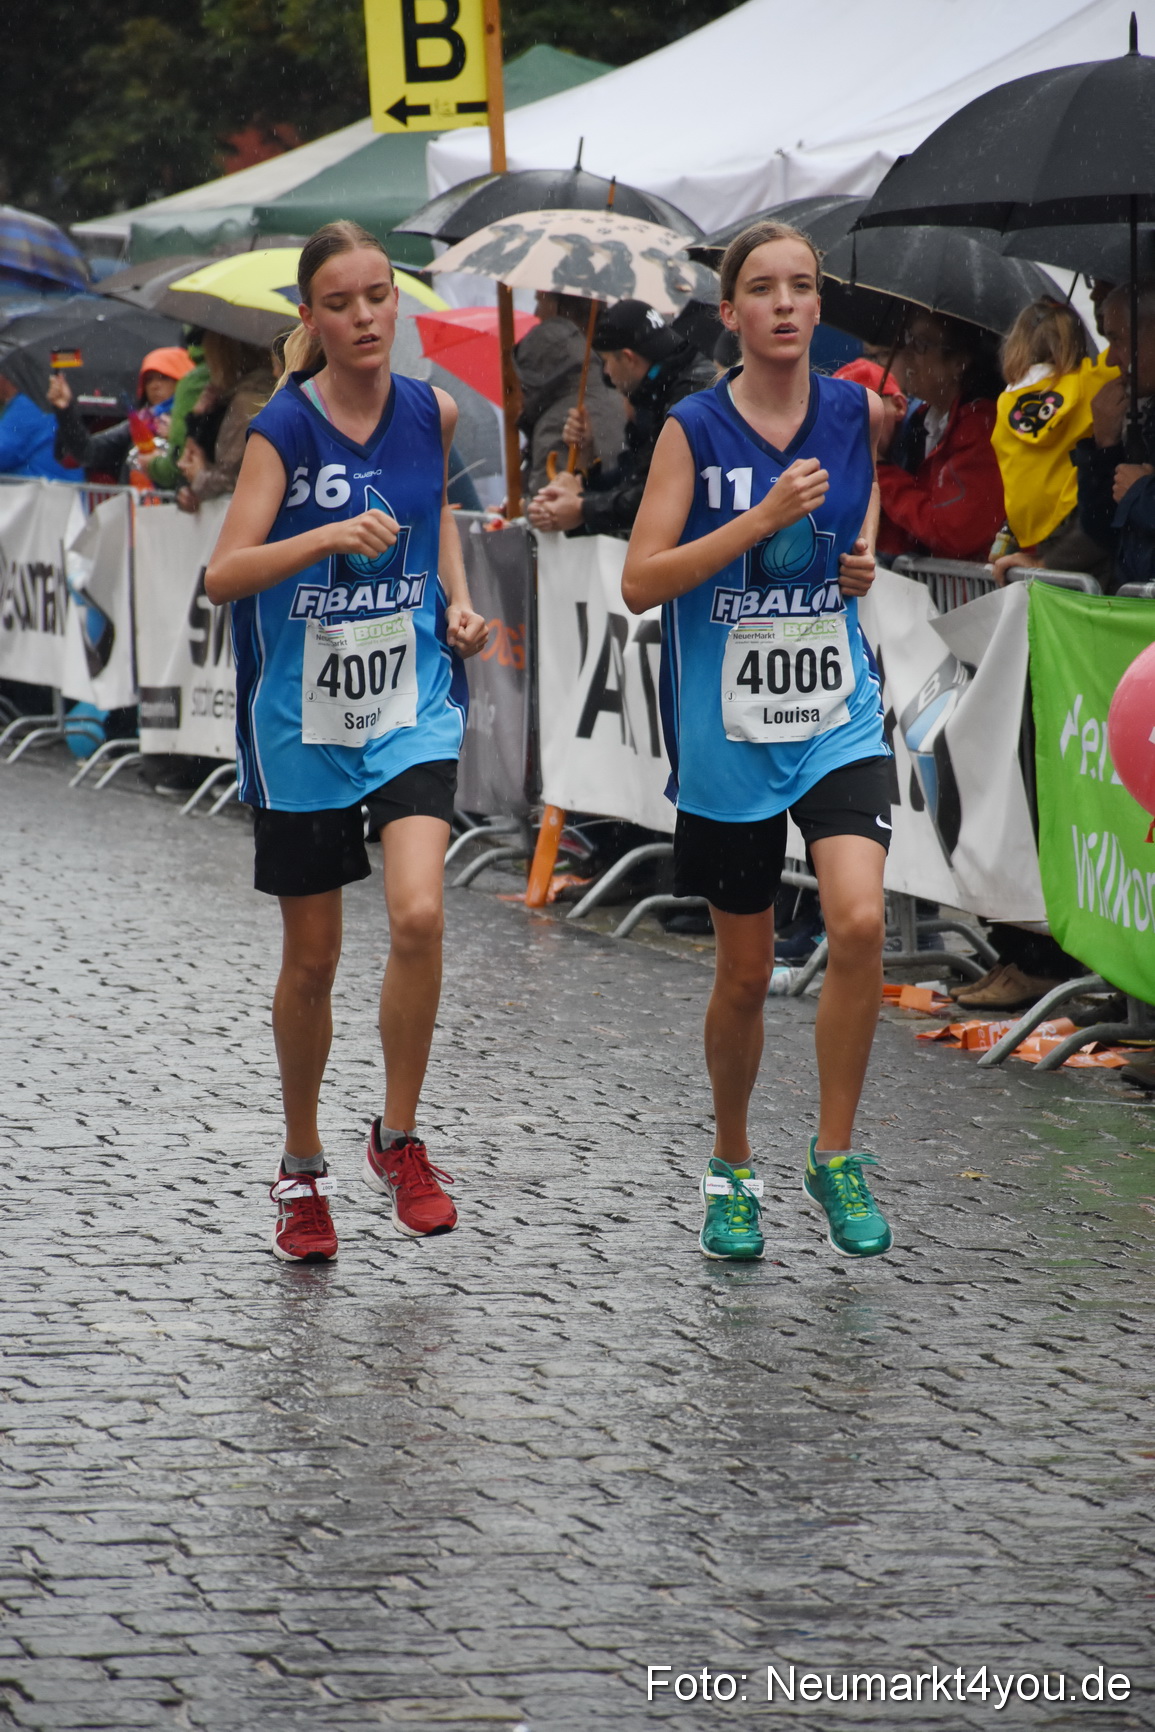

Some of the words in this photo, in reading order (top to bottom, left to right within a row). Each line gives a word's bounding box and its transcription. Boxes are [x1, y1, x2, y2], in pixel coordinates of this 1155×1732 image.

[401, 0, 466, 84] B
[701, 466, 753, 510] 11
[353, 617, 406, 642] BOCK
[733, 632, 775, 640] NeuerMarkt
[317, 644, 407, 700] 4007
[737, 645, 842, 695] 4006
[763, 706, 820, 724] Louisa
